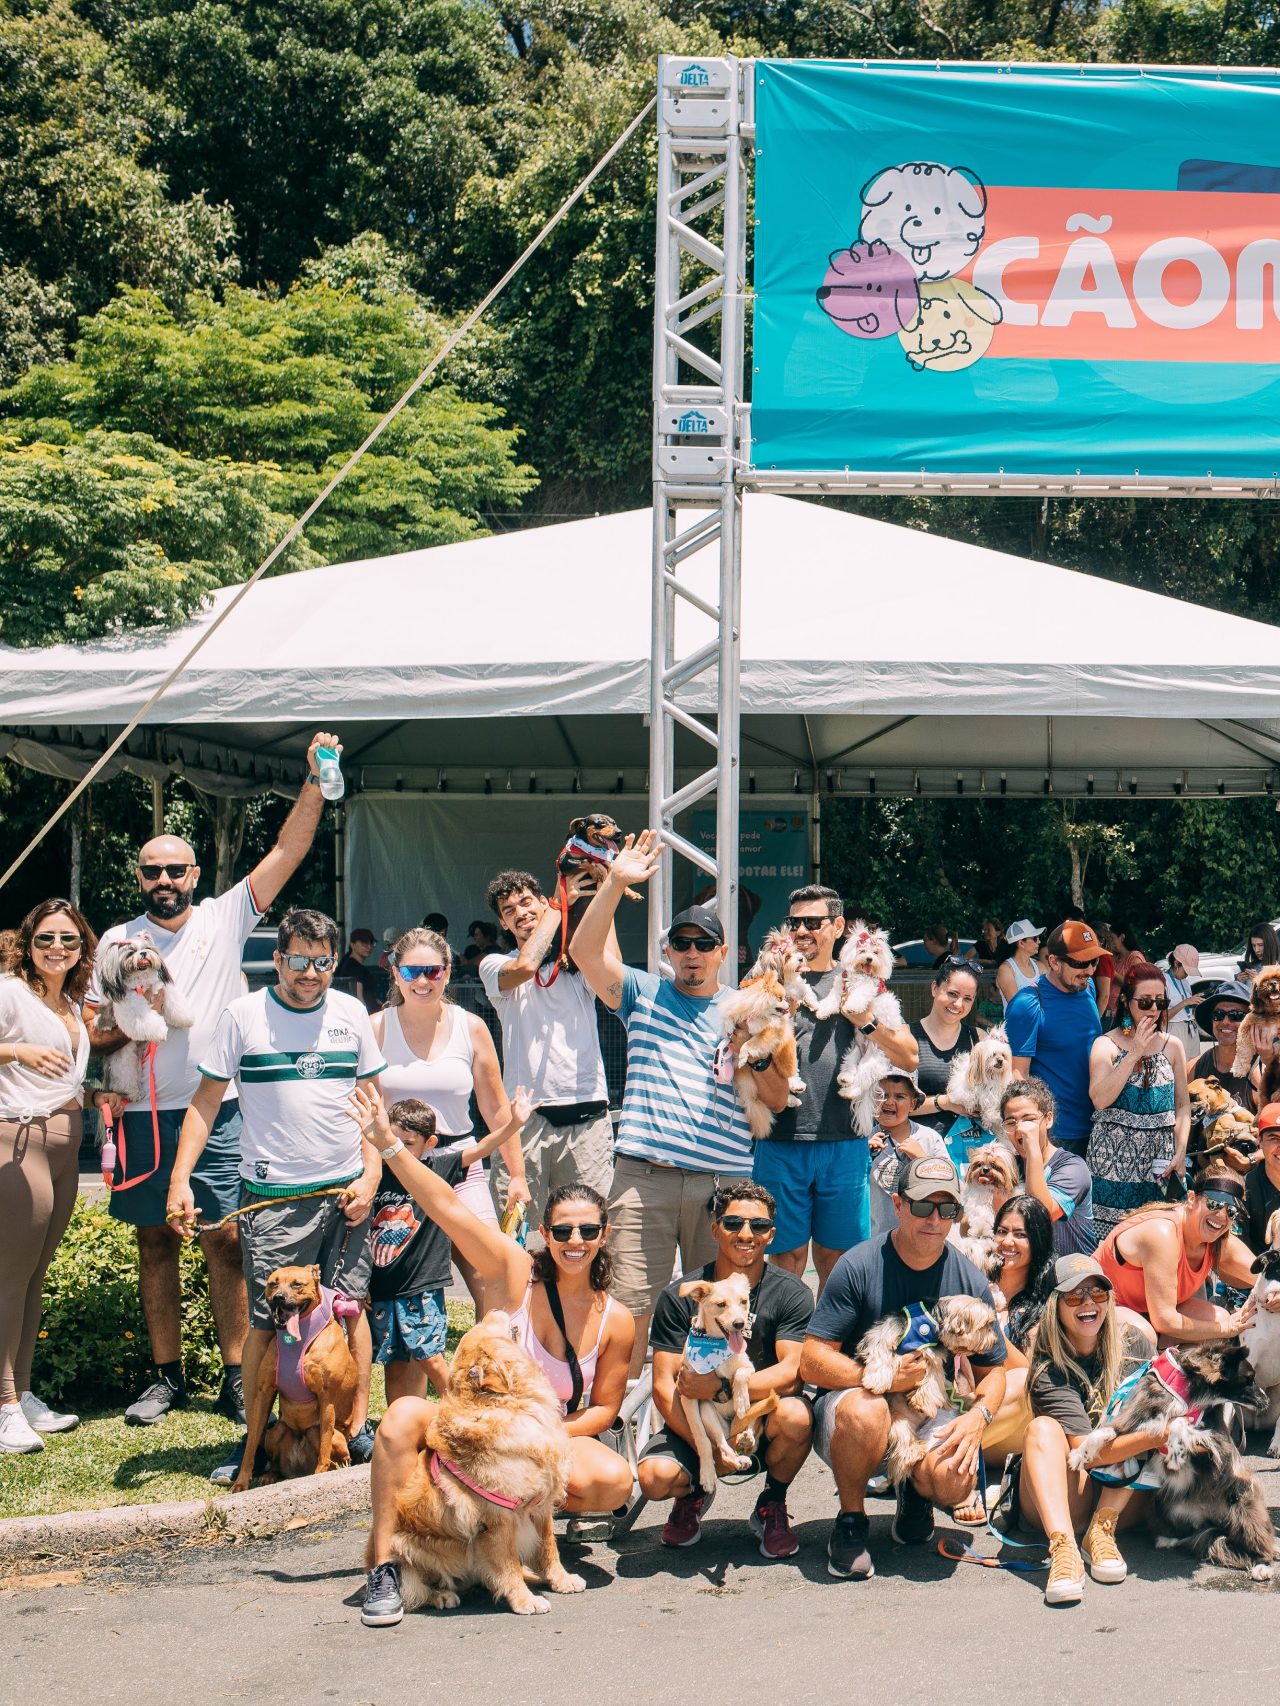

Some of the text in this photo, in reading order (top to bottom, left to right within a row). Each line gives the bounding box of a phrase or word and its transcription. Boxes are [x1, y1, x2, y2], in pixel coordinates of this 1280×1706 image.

[681, 72, 709, 86] DELTA
[678, 419, 708, 433] DELTA
[780, 865, 804, 877] ELE!
[328, 1027, 350, 1037] COXA
